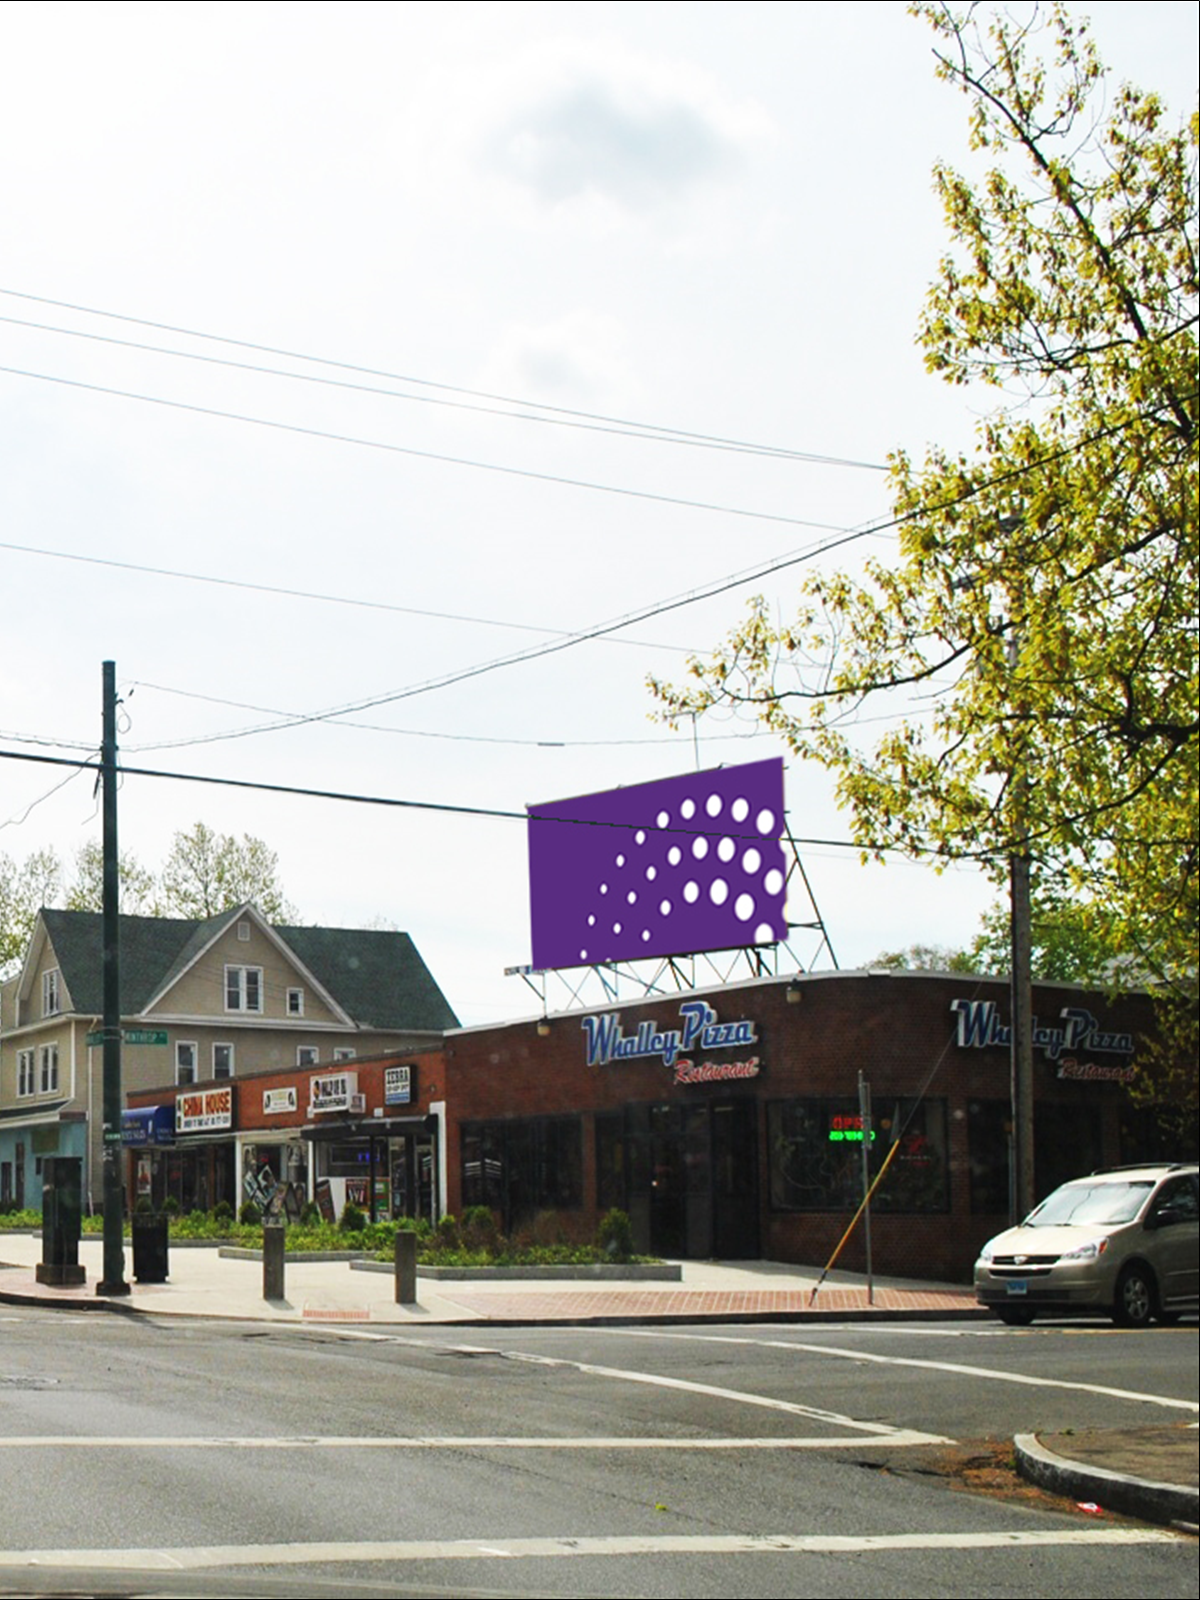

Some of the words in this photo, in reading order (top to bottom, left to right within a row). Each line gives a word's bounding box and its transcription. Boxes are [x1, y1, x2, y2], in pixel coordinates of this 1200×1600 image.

[581, 1012, 680, 1066] Whalley
[679, 1001, 758, 1050] Pizza
[1060, 1007, 1134, 1052] Pizza
[674, 1057, 759, 1085] Restaurant
[183, 1094, 203, 1118] CHINA
[205, 1090, 230, 1115] HOUSE
